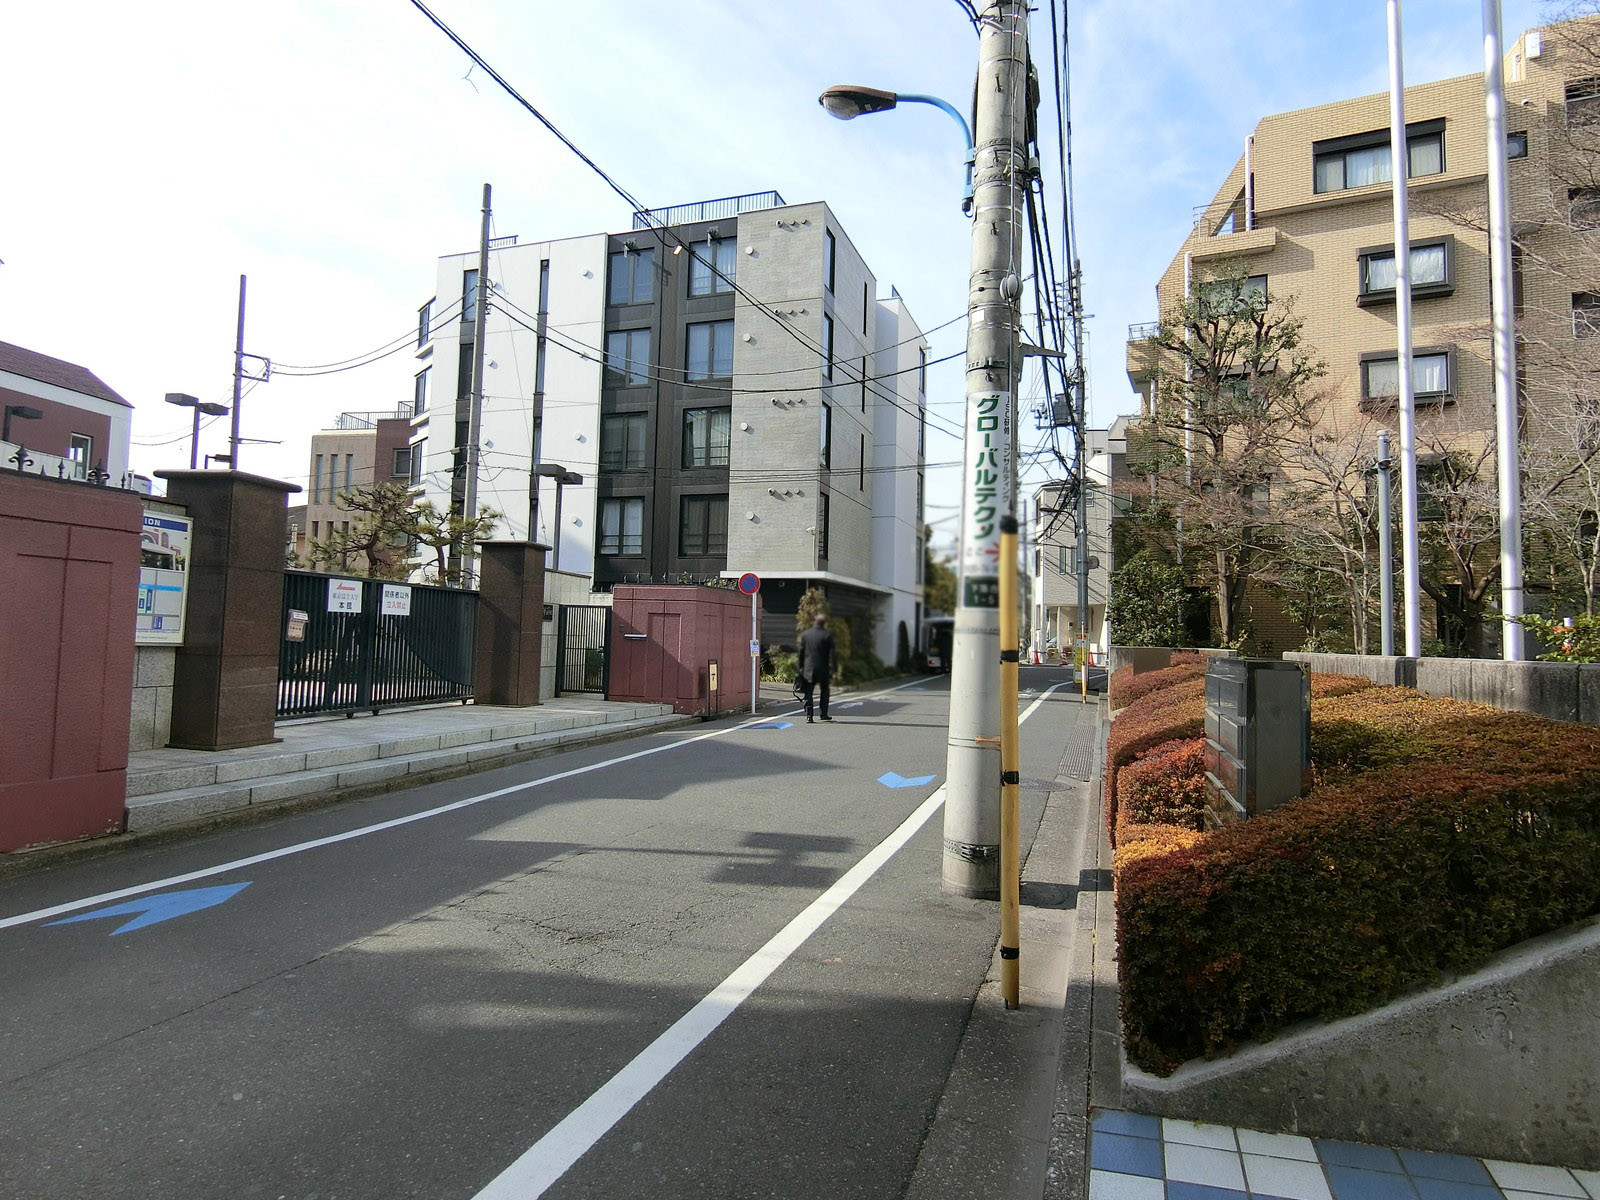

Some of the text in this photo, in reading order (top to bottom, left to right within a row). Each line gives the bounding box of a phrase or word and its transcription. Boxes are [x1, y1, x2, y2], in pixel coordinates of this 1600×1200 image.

[975, 394, 1000, 539] グローバルテクノ
[385, 590, 410, 599] 関係者以外
[386, 601, 407, 610] 立入禁止
